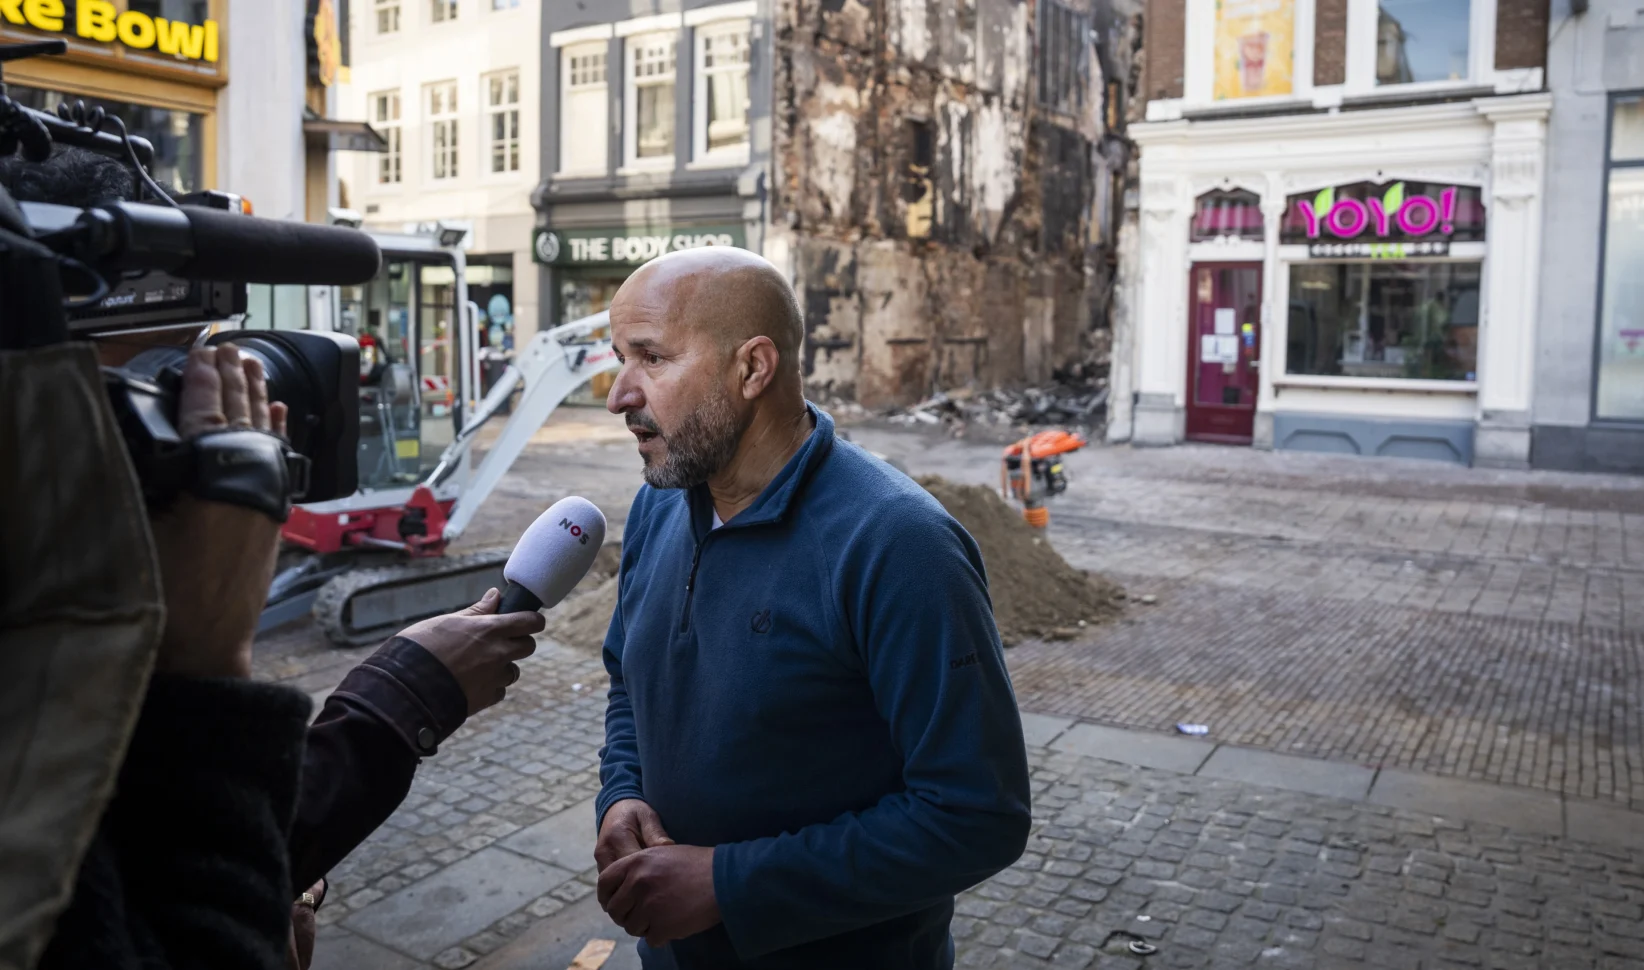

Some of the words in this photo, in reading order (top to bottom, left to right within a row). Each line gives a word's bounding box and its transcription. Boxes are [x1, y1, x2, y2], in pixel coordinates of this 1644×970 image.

[1297, 181, 1458, 239] YOYO!
[568, 237, 609, 261] THE
[612, 235, 671, 262] BODY
[558, 517, 590, 546] NOS
